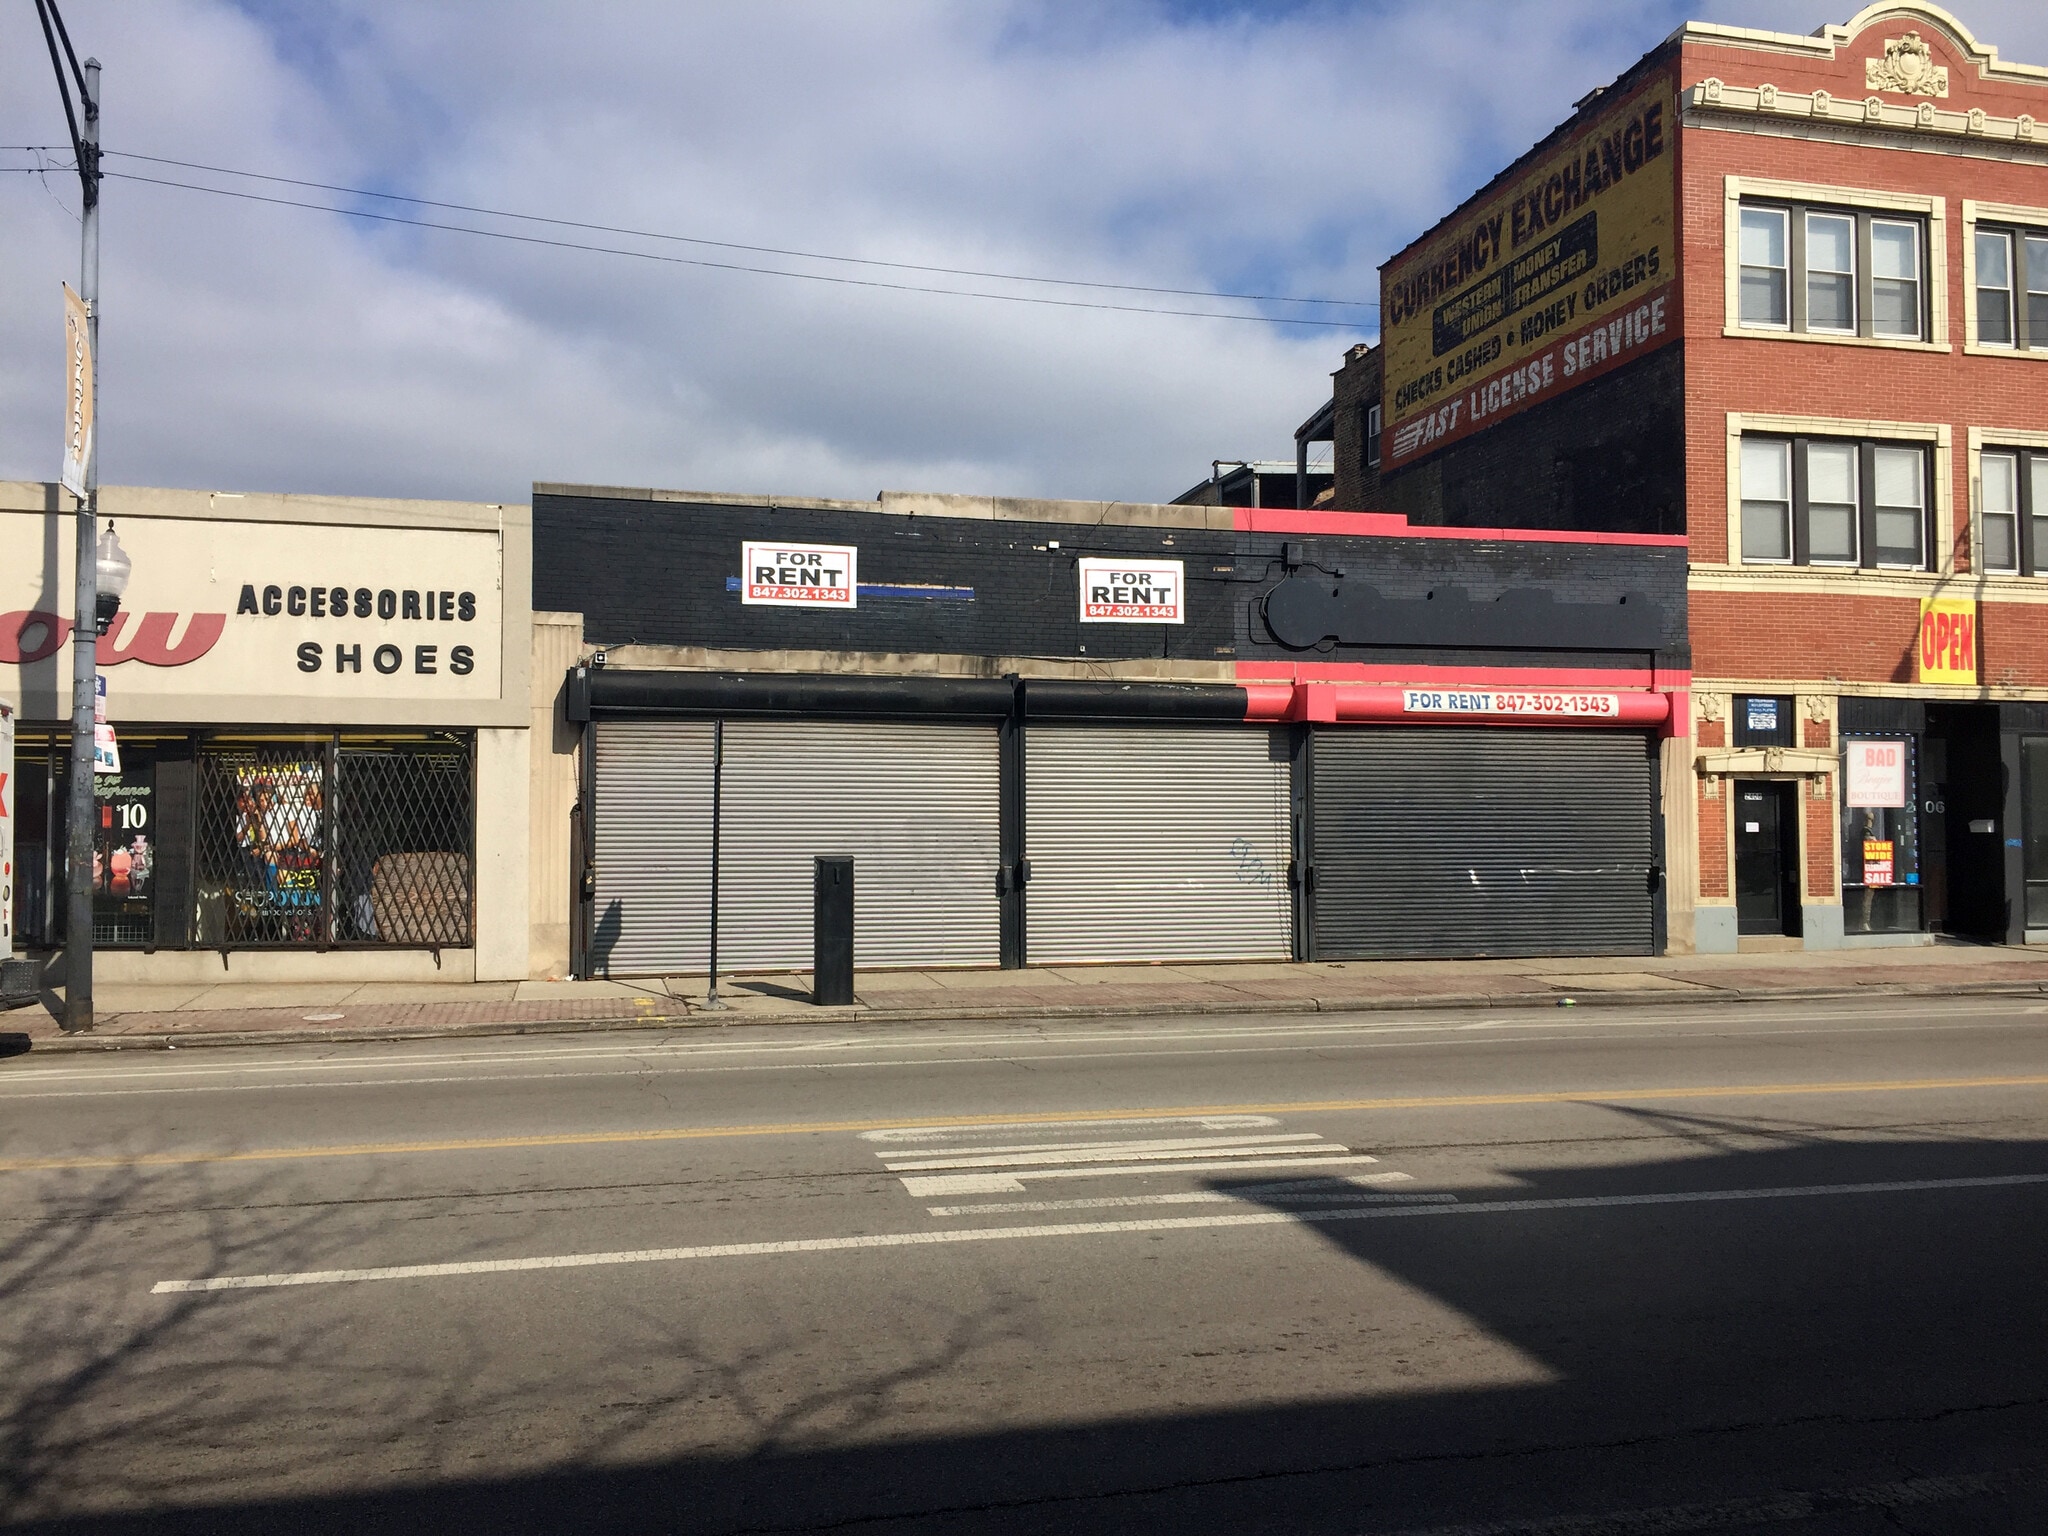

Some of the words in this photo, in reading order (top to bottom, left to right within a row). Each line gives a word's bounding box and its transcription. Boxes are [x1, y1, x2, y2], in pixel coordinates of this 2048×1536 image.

[1389, 211, 1504, 325] CURRENCY
[1512, 101, 1664, 246] EXCHANGE
[1514, 237, 1562, 282] MONEY
[1514, 249, 1587, 308] TRANSFER
[1443, 277, 1502, 325] WESTERN
[1395, 368, 1442, 411] CHECKS
[1447, 335, 1502, 383] CASHED
[1521, 291, 1577, 346] MONEY
[1584, 246, 1660, 309] ORDERS
[1462, 299, 1504, 338] UNION
[1404, 407, 1458, 457] FAST
[1471, 353, 1554, 420] LICENSE
[1564, 297, 1666, 377] SERVICE
[776, 552, 822, 567] FOR
[755, 566, 843, 588] RENT
[1109, 572, 1153, 586] FOR
[236, 583, 477, 622] ACCESSORIES
[753, 587, 847, 602] 847.302.1343
[1091, 586, 1171, 604] RENT
[1089, 605, 1175, 618] 847.302.1343
[1922, 611, 1975, 671] OPEN
[297, 641, 476, 676] SHOES
[1409, 692, 1443, 712] FOR
[1448, 693, 1491, 711] RENT
[1496, 694, 1611, 713] 847-302-1343
[1865, 748, 1896, 767] BAD
[1851, 792, 1900, 801] BOUTIQUE
[116, 803, 147, 829] $10
[1865, 842, 1892, 851] STORE
[1865, 852, 1892, 860] WIDE
[1865, 873, 1892, 883] SALE
